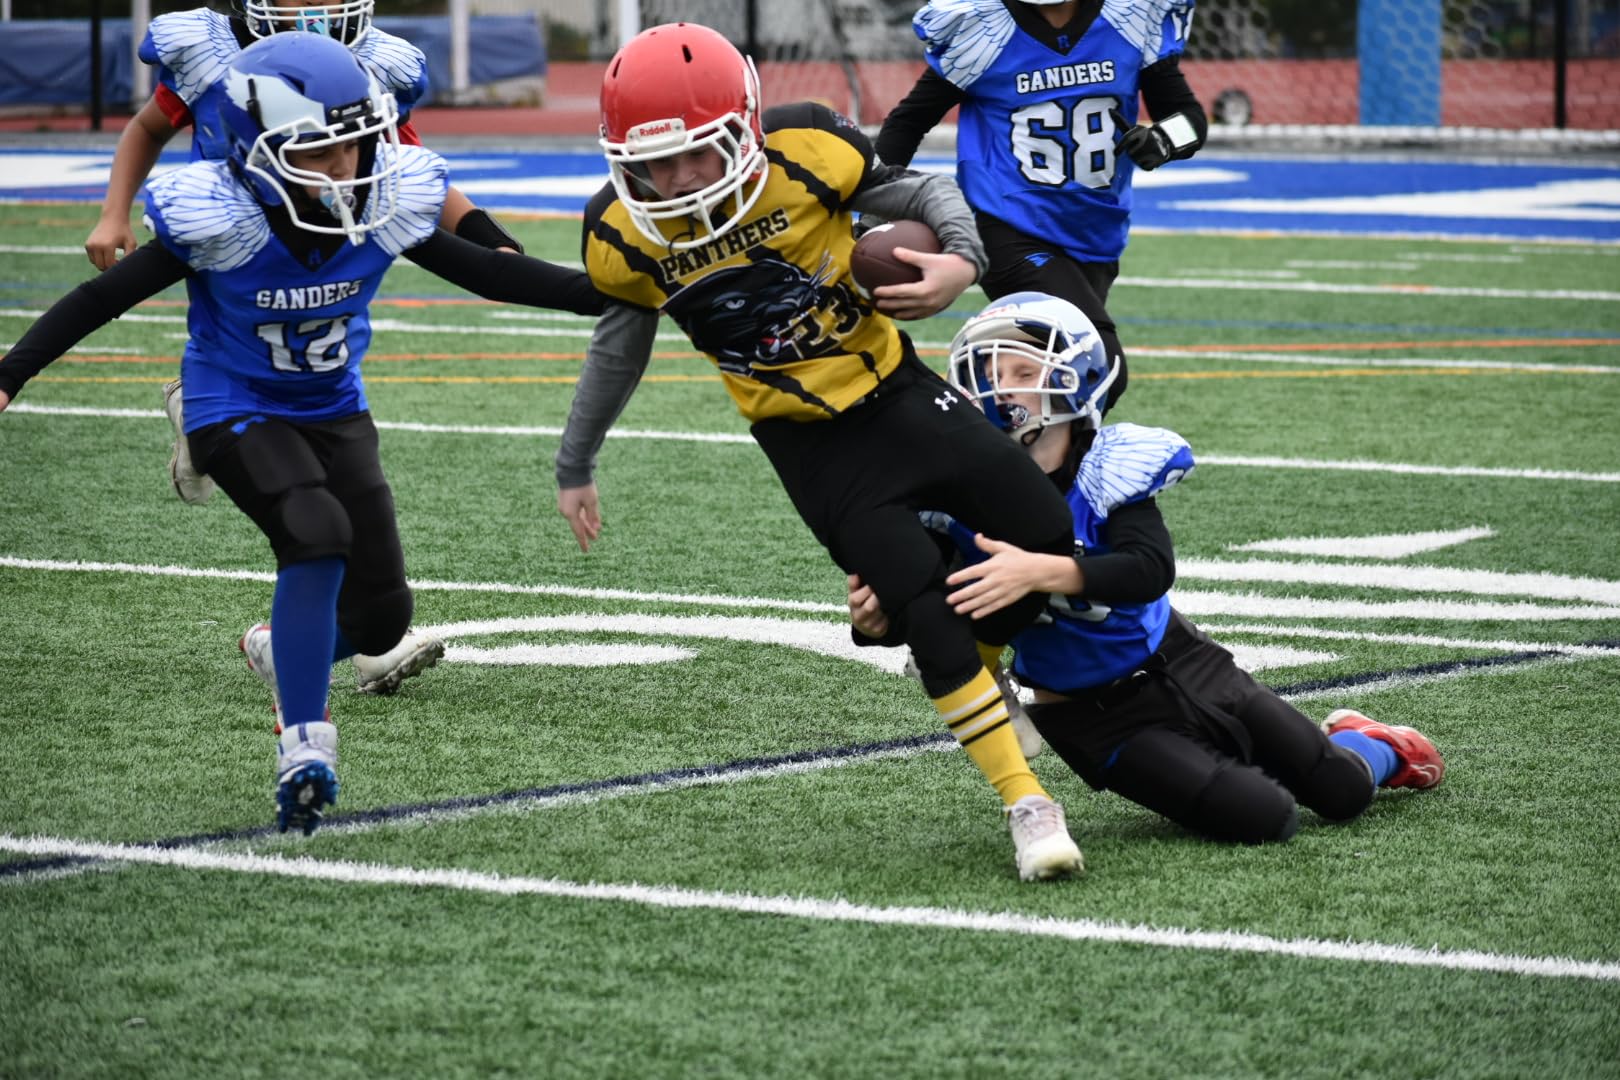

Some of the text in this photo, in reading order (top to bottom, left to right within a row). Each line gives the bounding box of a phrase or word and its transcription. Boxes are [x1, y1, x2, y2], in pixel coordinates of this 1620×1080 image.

[1016, 60, 1116, 94] GANDERS
[640, 122, 672, 137] Riddell
[1010, 96, 1119, 189] 68
[658, 207, 791, 284] PANTHERS
[256, 279, 362, 310] GANDERS
[255, 312, 352, 373] 12
